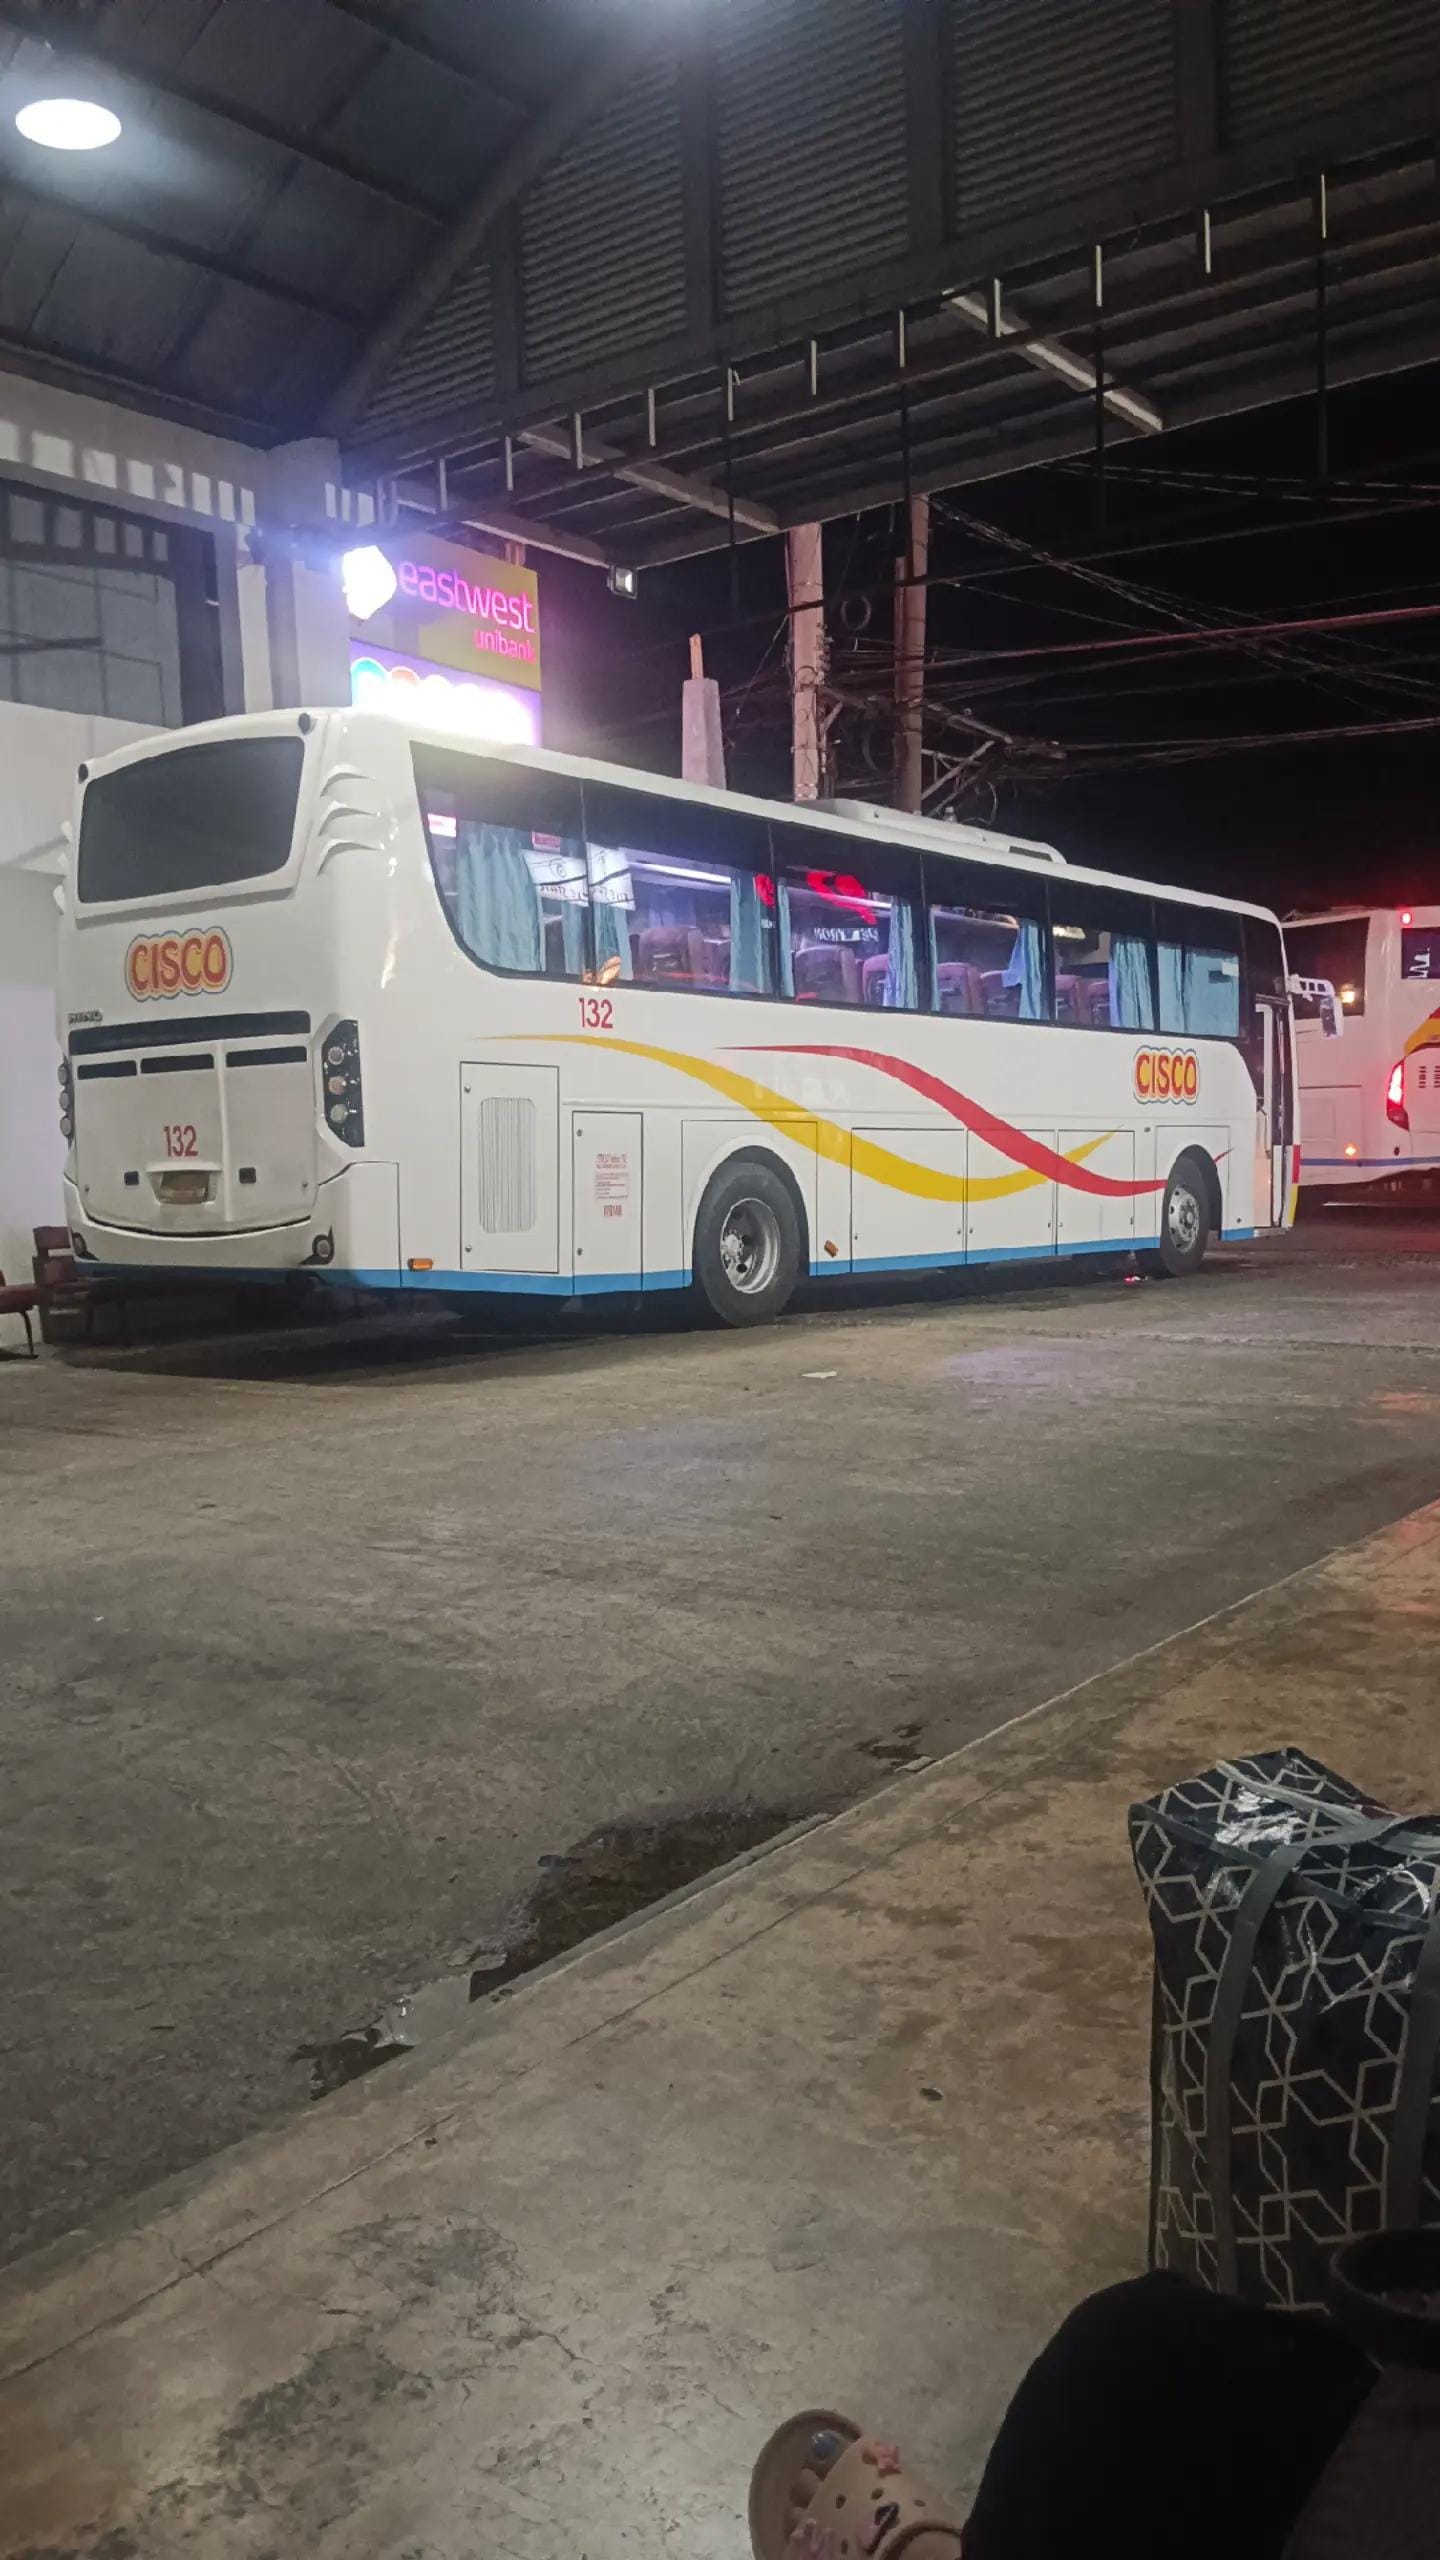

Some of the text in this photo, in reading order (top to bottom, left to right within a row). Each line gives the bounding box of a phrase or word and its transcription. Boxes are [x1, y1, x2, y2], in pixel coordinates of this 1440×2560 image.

[399, 561, 535, 633] eastwest
[474, 629, 536, 665] unibank
[129, 932, 228, 993] CISCO
[579, 997, 614, 1029] 132
[1135, 1051, 1198, 1100] CISCO
[163, 1125, 199, 1157] 132
